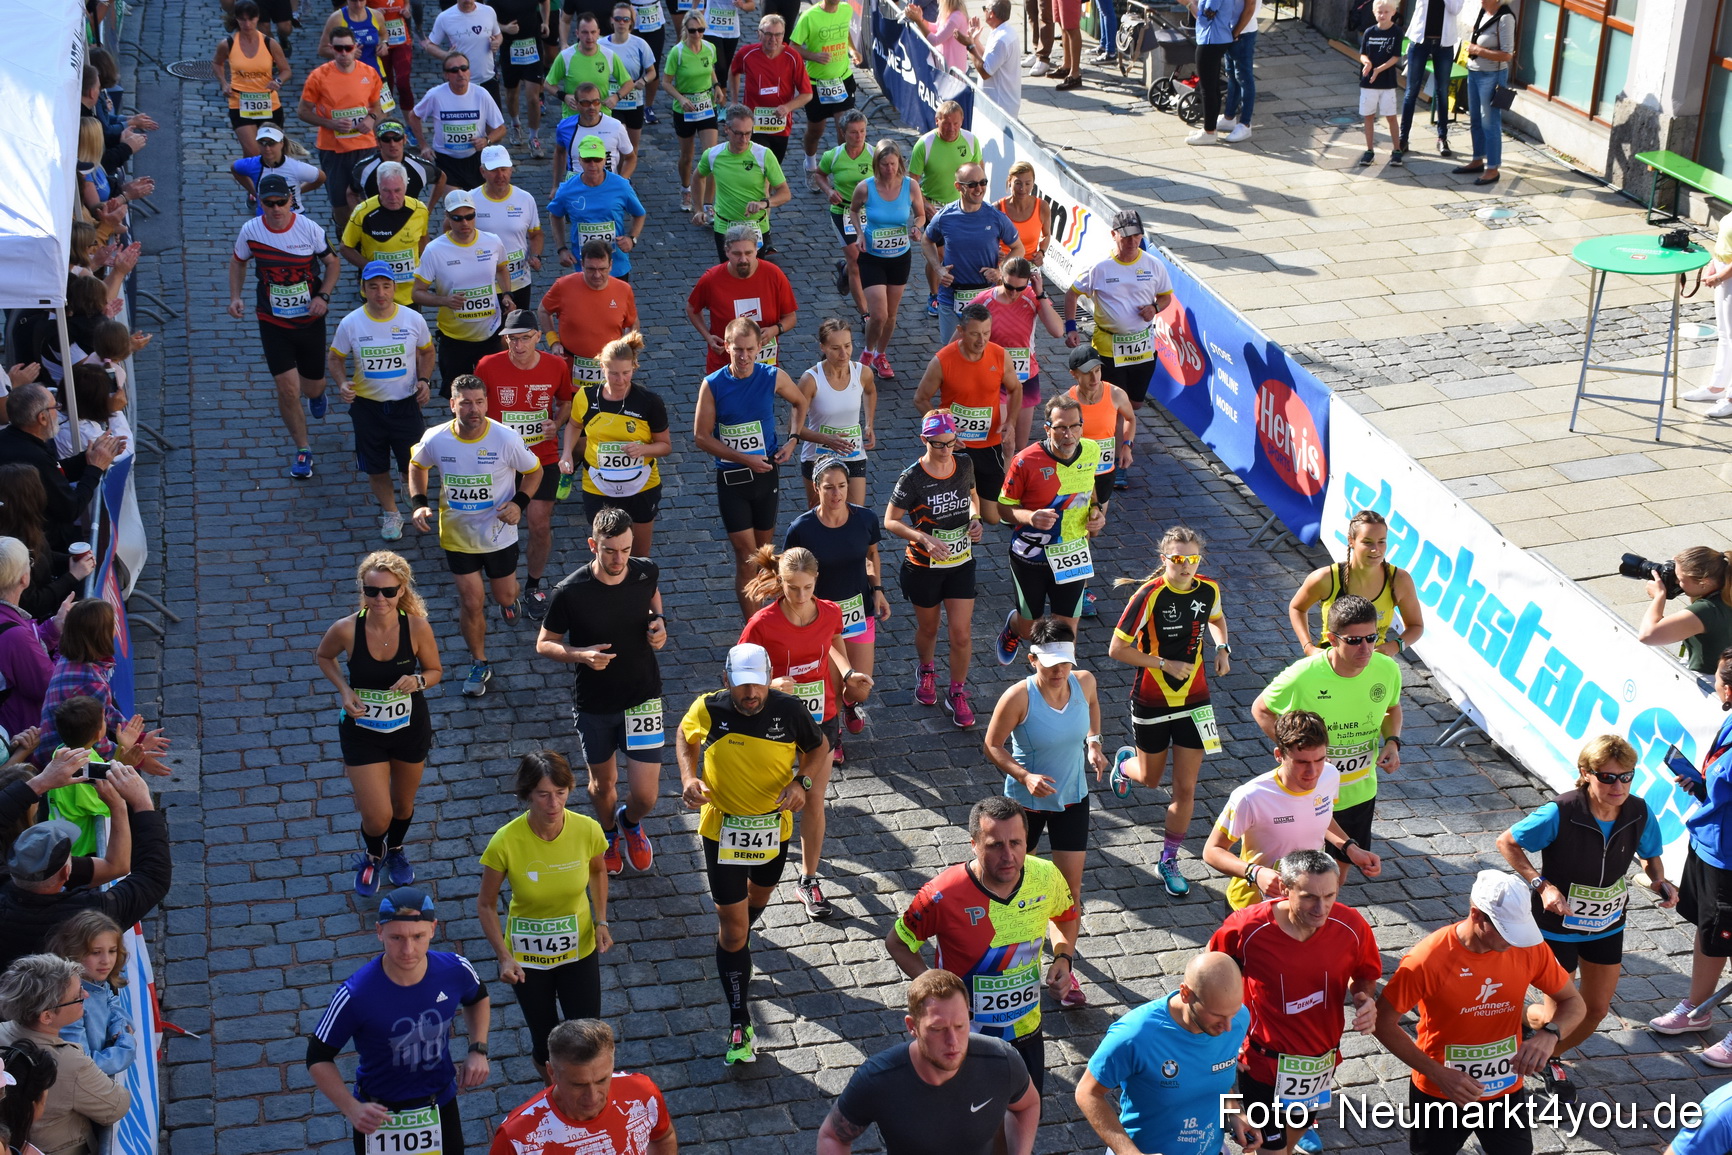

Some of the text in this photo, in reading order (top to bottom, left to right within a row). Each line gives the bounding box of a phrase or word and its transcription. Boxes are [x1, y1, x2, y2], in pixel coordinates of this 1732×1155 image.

[642, 14, 657, 23] 2157
[711, 17, 732, 25] 2551
[822, 42, 846, 52] MERZ
[821, 87, 842, 96] 2065
[758, 117, 782, 125] 1306
[580, 225, 611, 233] BOCK
[876, 230, 904, 238] BOCK
[876, 239, 903, 248] 2254
[377, 252, 411, 260] BOCK
[273, 286, 304, 295] BOCK
[274, 296, 307, 308] 2324
[1116, 331, 1147, 342] BOCK
[363, 345, 401, 356] BOCK
[1118, 341, 1147, 355] 1147
[1210, 342, 1234, 365] STORE
[366, 357, 402, 370] 2779
[1218, 368, 1239, 396] ONLINE
[954, 405, 988, 417] BOCK
[1216, 394, 1238, 424] MOBILE
[507, 413, 544, 422] BOCK
[720, 425, 758, 436] BOCK
[1260, 385, 1321, 482] Hervis
[603, 456, 639, 468] 2607
[447, 476, 487, 486] BOCK
[450, 488, 489, 501] 2448
[927, 490, 959, 506] HECK
[932, 498, 972, 515] DESIGN
[1050, 541, 1086, 555] BOCK
[1054, 551, 1089, 570] 2693
[360, 691, 406, 702] BOCK
[364, 703, 407, 718] 2710
[731, 815, 775, 828] BOCK
[728, 832, 773, 848] 1341
[734, 851, 765, 859] BERND
[1576, 884, 1623, 899] BOCK
[1574, 898, 1622, 917] 2293
[516, 919, 572, 932] BOCK
[1578, 915, 1613, 927] MARGIT
[520, 936, 571, 952] 1143
[523, 953, 568, 964] BRIGITTE
[979, 972, 1034, 992] BOCK
[982, 986, 1034, 1011] 2696
[1473, 1005, 1516, 1017] neumarkt
[1453, 1043, 1509, 1058] BOCK
[1212, 1056, 1237, 1072] BOCK
[1285, 1057, 1332, 1071] BOCK
[1283, 1072, 1329, 1096] 2577
[375, 1131, 433, 1151] 1103
